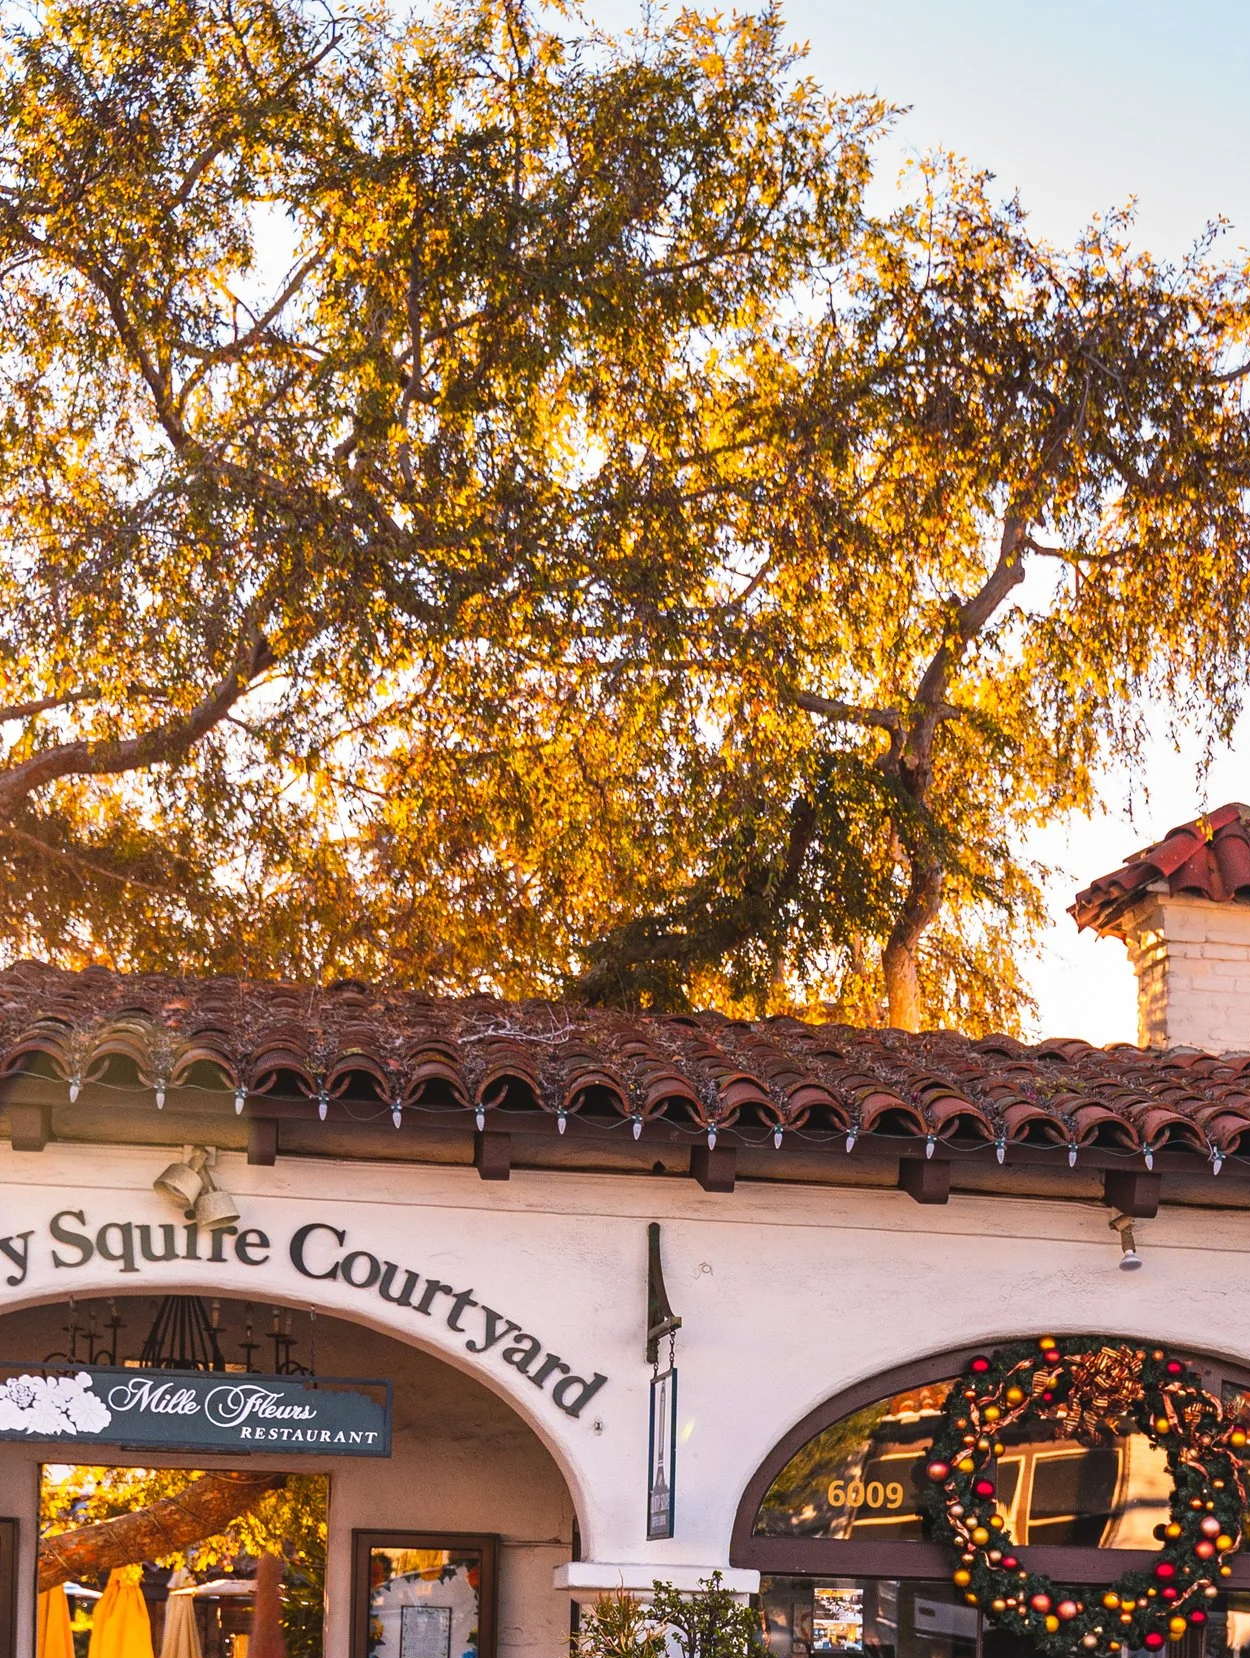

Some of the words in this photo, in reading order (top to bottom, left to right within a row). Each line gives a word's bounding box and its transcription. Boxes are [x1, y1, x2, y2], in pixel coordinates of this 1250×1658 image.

[49, 1209, 271, 1273] Squire
[289, 1222, 609, 1420] Courtyard
[108, 1377, 201, 1415] Mille
[204, 1384, 318, 1428] Fleurs
[240, 1426, 379, 1445] RESTAURANT
[827, 1479, 904, 1509] 6009
